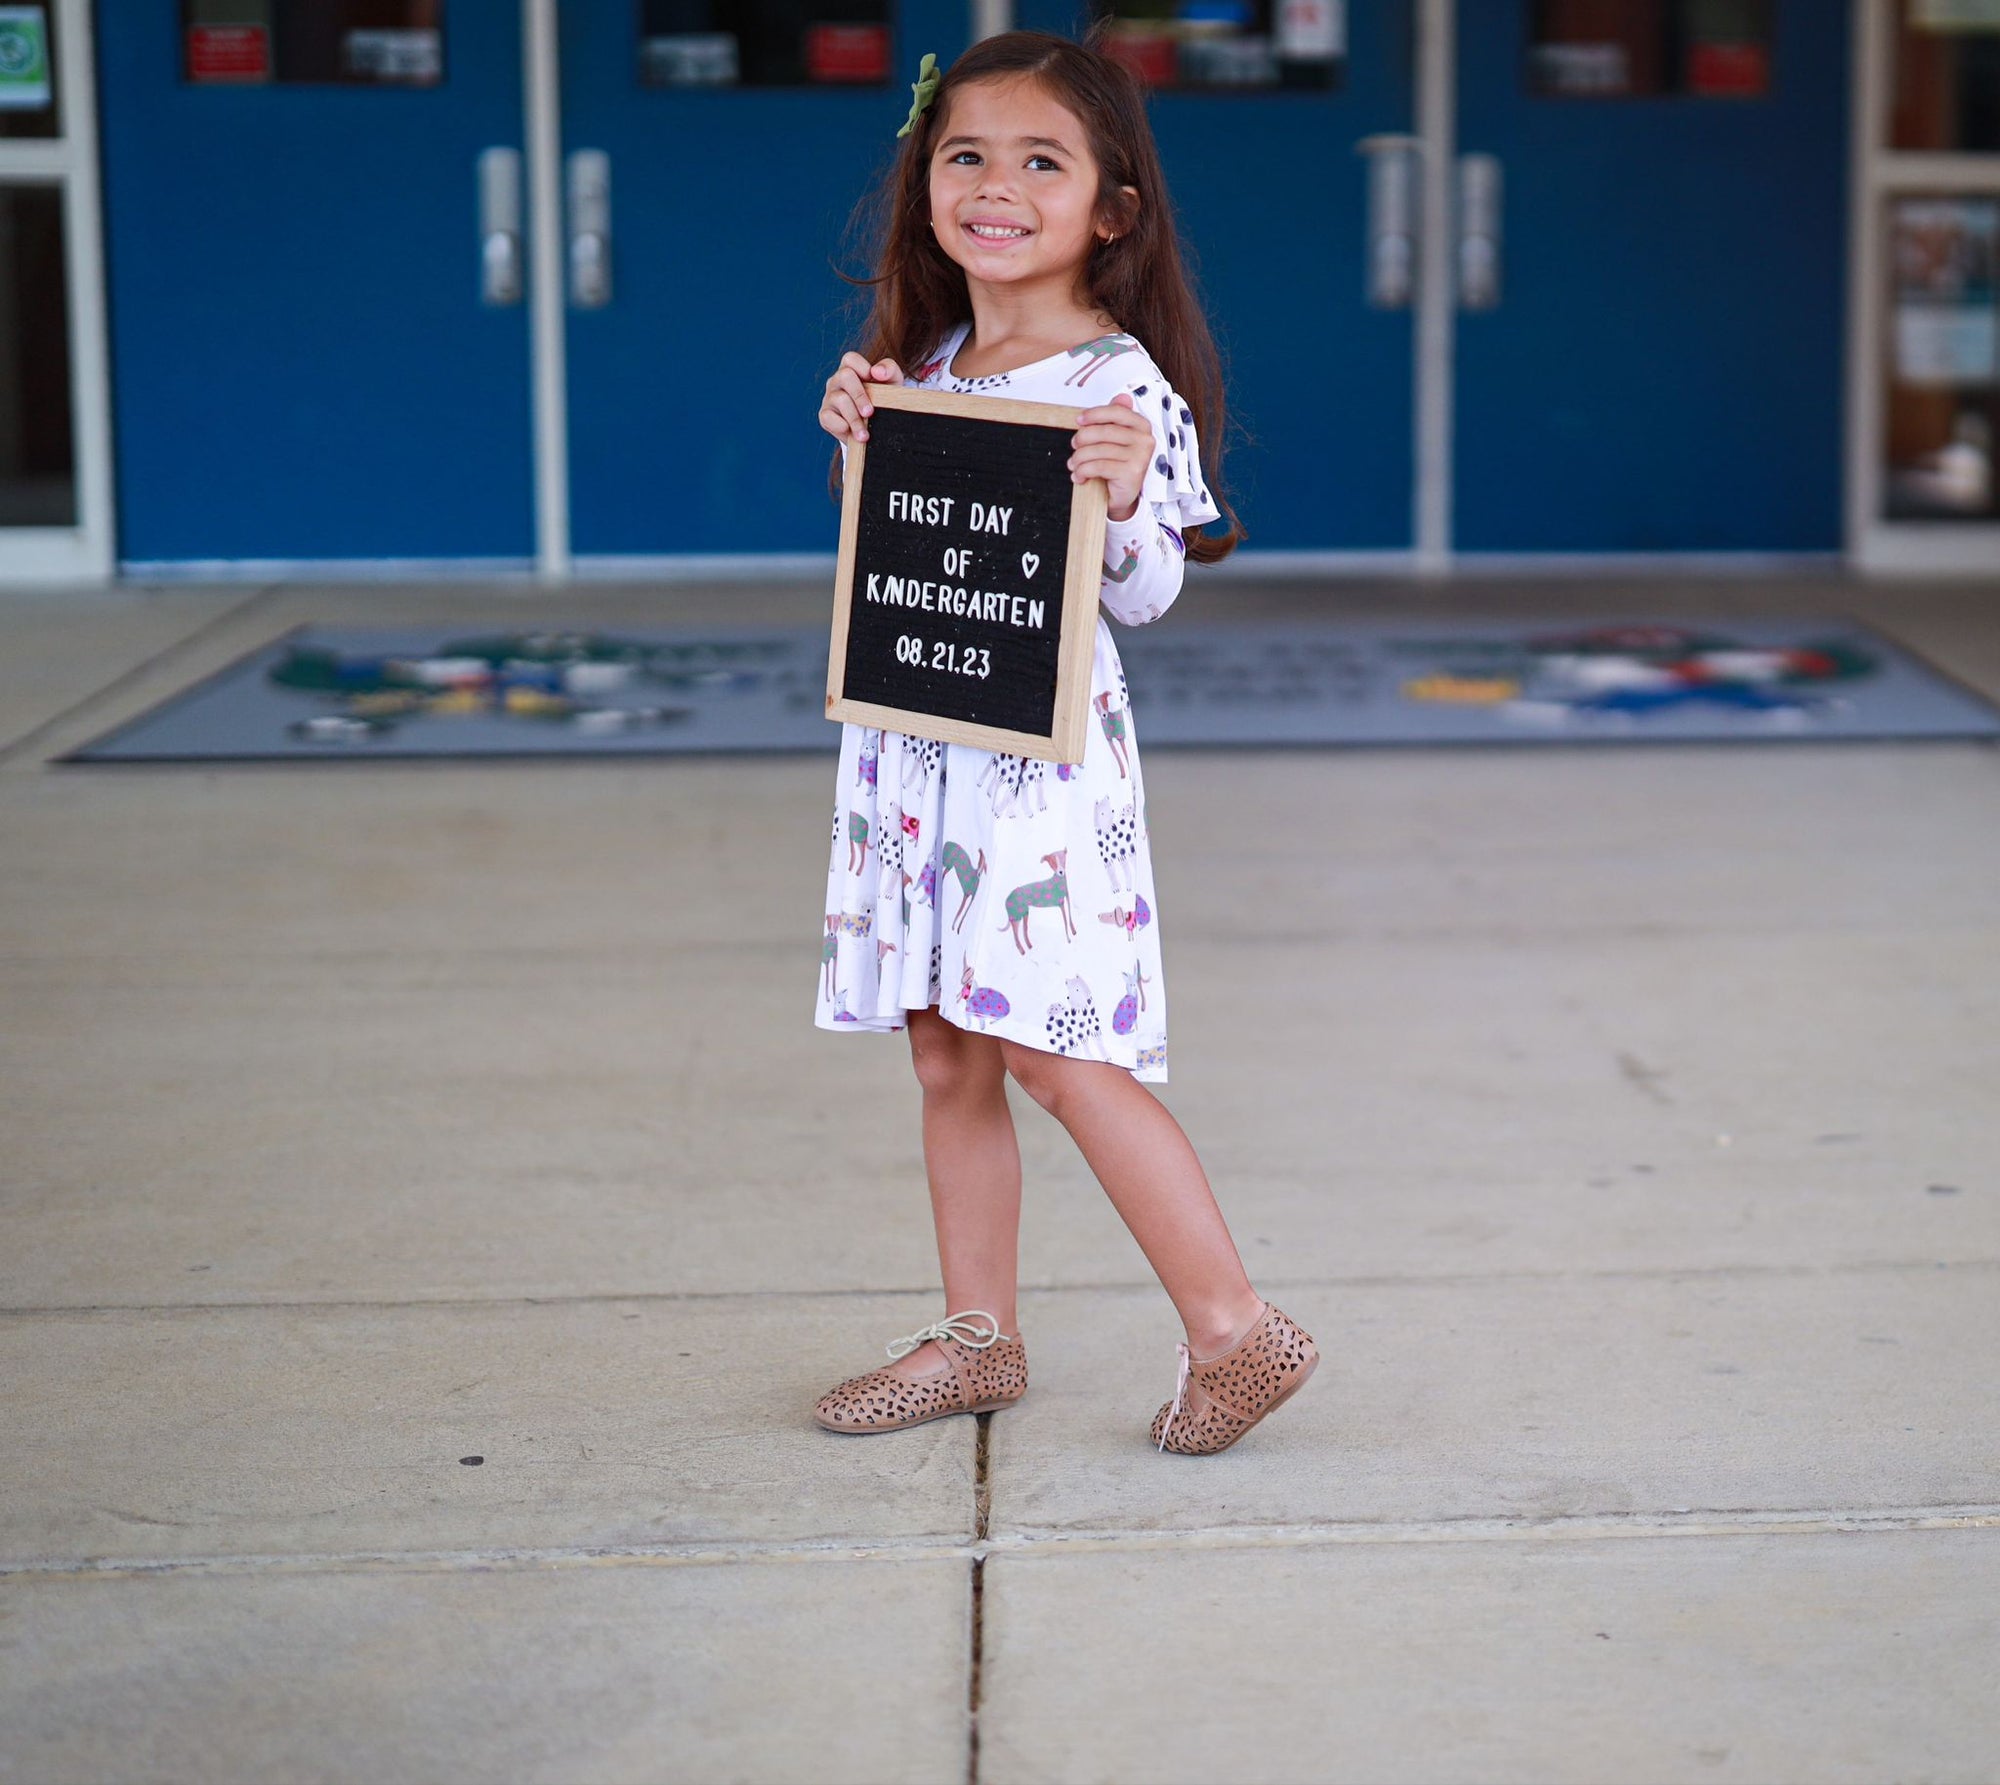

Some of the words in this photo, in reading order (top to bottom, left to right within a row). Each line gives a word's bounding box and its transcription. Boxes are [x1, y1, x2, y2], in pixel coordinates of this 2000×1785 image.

[888, 490, 955, 527] FIRST
[969, 502, 1014, 536] DAY
[943, 547, 974, 579] OF
[866, 572, 1045, 630] KINDERGARTEN
[895, 634, 991, 680] 08.21.23
